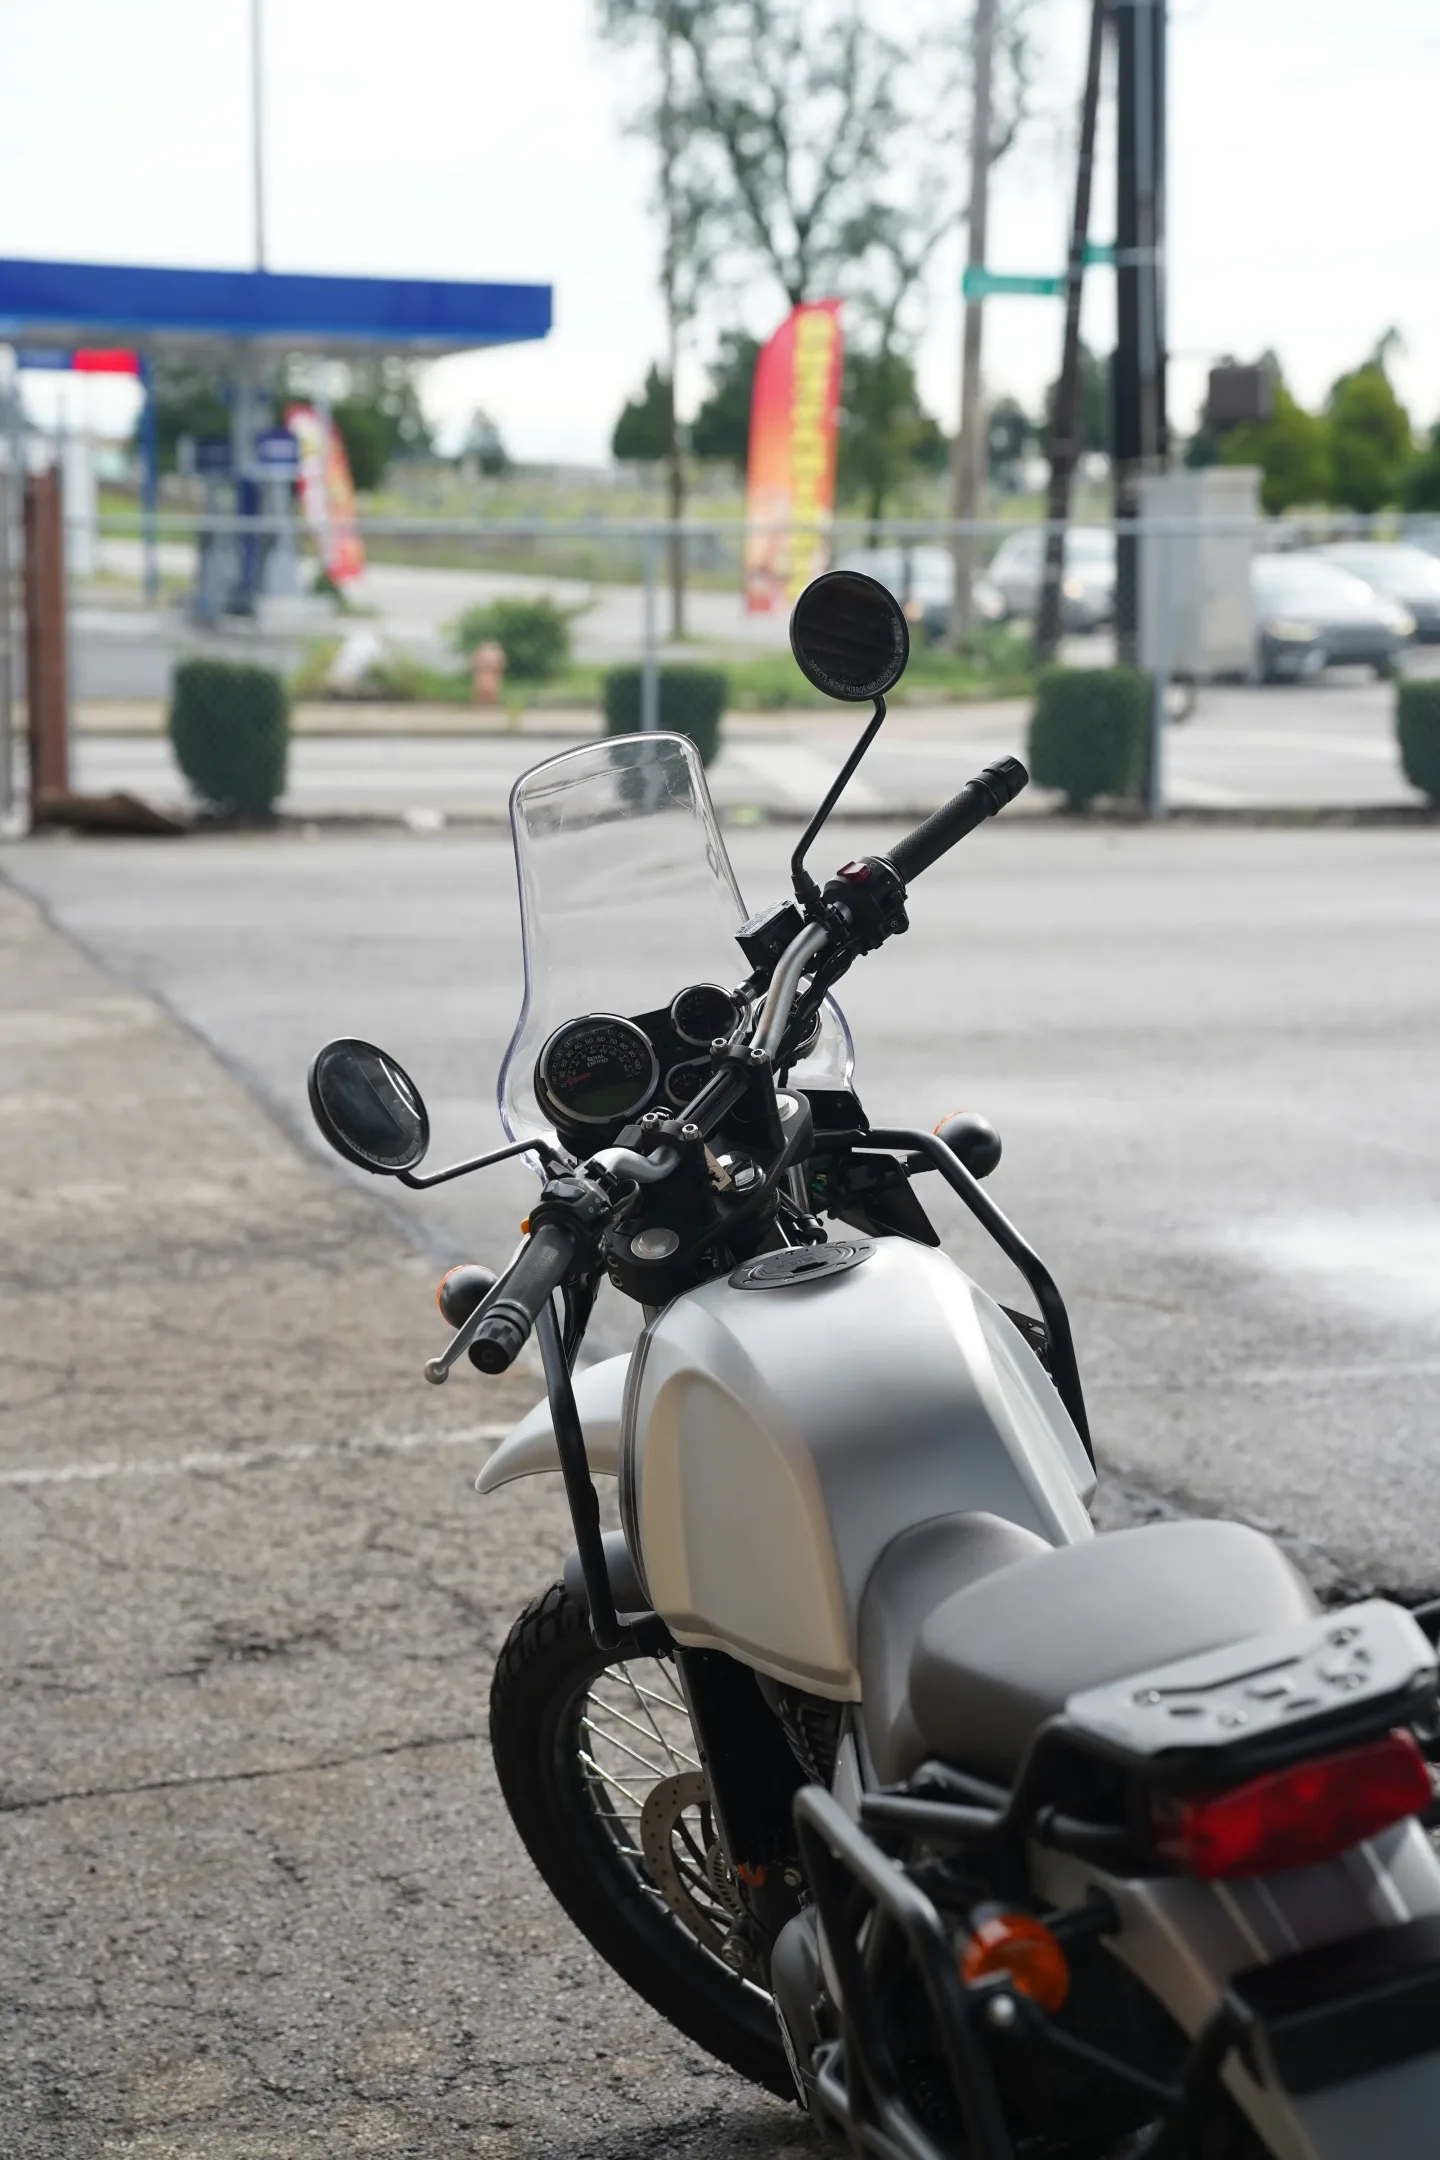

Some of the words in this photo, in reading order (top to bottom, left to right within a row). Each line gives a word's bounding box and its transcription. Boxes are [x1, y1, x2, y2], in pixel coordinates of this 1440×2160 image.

[808, 660, 828, 682] OBJECTS
[834, 682, 846, 692] THE
[846, 685, 867, 694] MIRROR
[866, 682, 878, 691] ARE
[876, 669, 894, 686] CLOSER
[560, 1059, 568, 1068] 20
[565, 1050, 574, 1058] 30
[584, 1037, 594, 1045] 50
[608, 1037, 618, 1045] 70
[619, 1042, 629, 1050] 80
[628, 1049, 636, 1058] 90
[633, 1058, 642, 1070] 100
[586, 1054, 605, 1062] ROYAL
